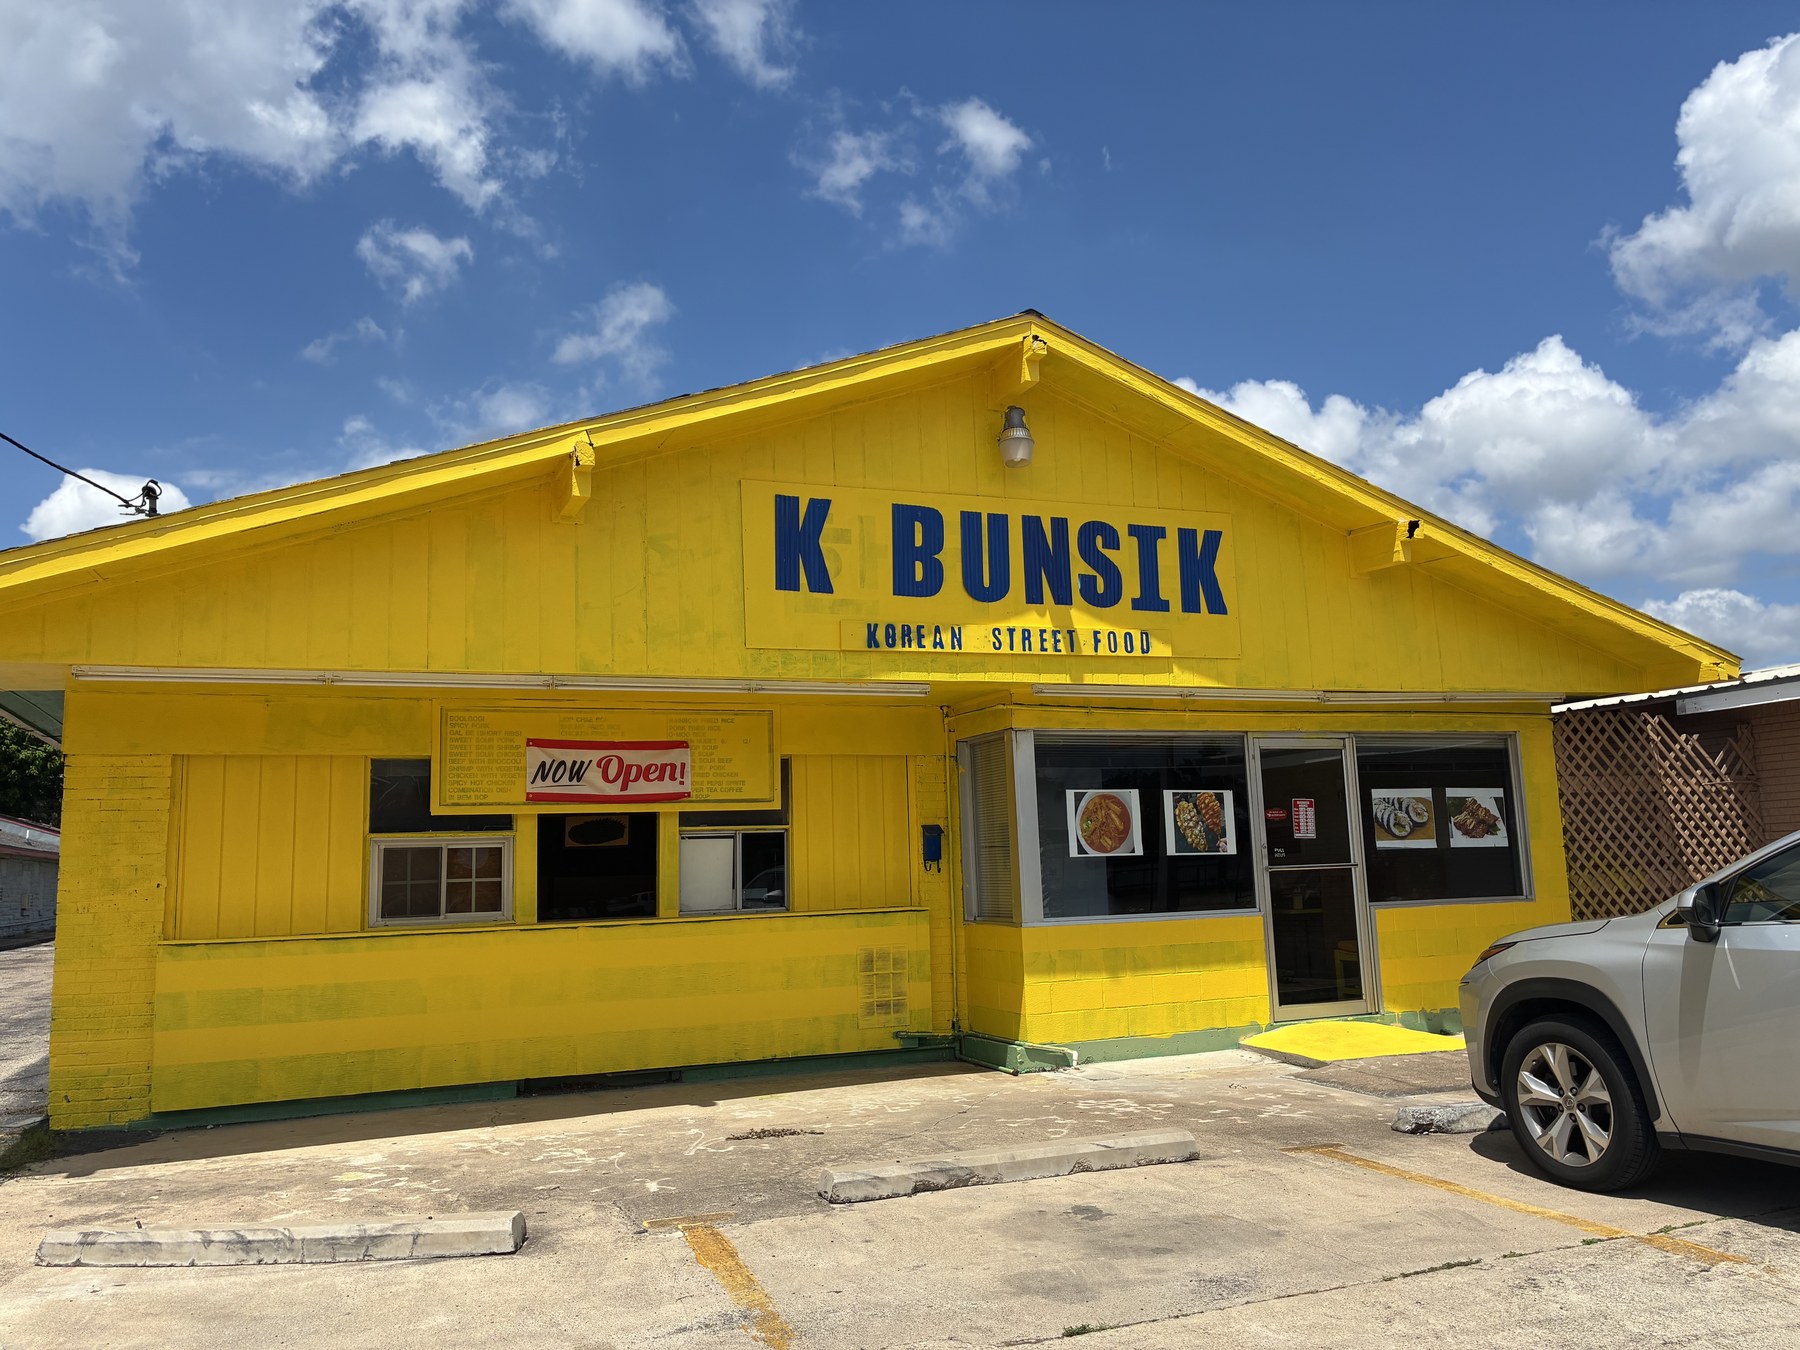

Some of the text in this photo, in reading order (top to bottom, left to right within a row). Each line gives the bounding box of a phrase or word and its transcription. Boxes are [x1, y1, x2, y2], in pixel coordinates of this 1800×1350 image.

[775, 494, 1229, 616] K BUNSIK
[866, 623, 1152, 655] KOREAN STREET FOOD
[531, 754, 686, 792] NOW Open!
